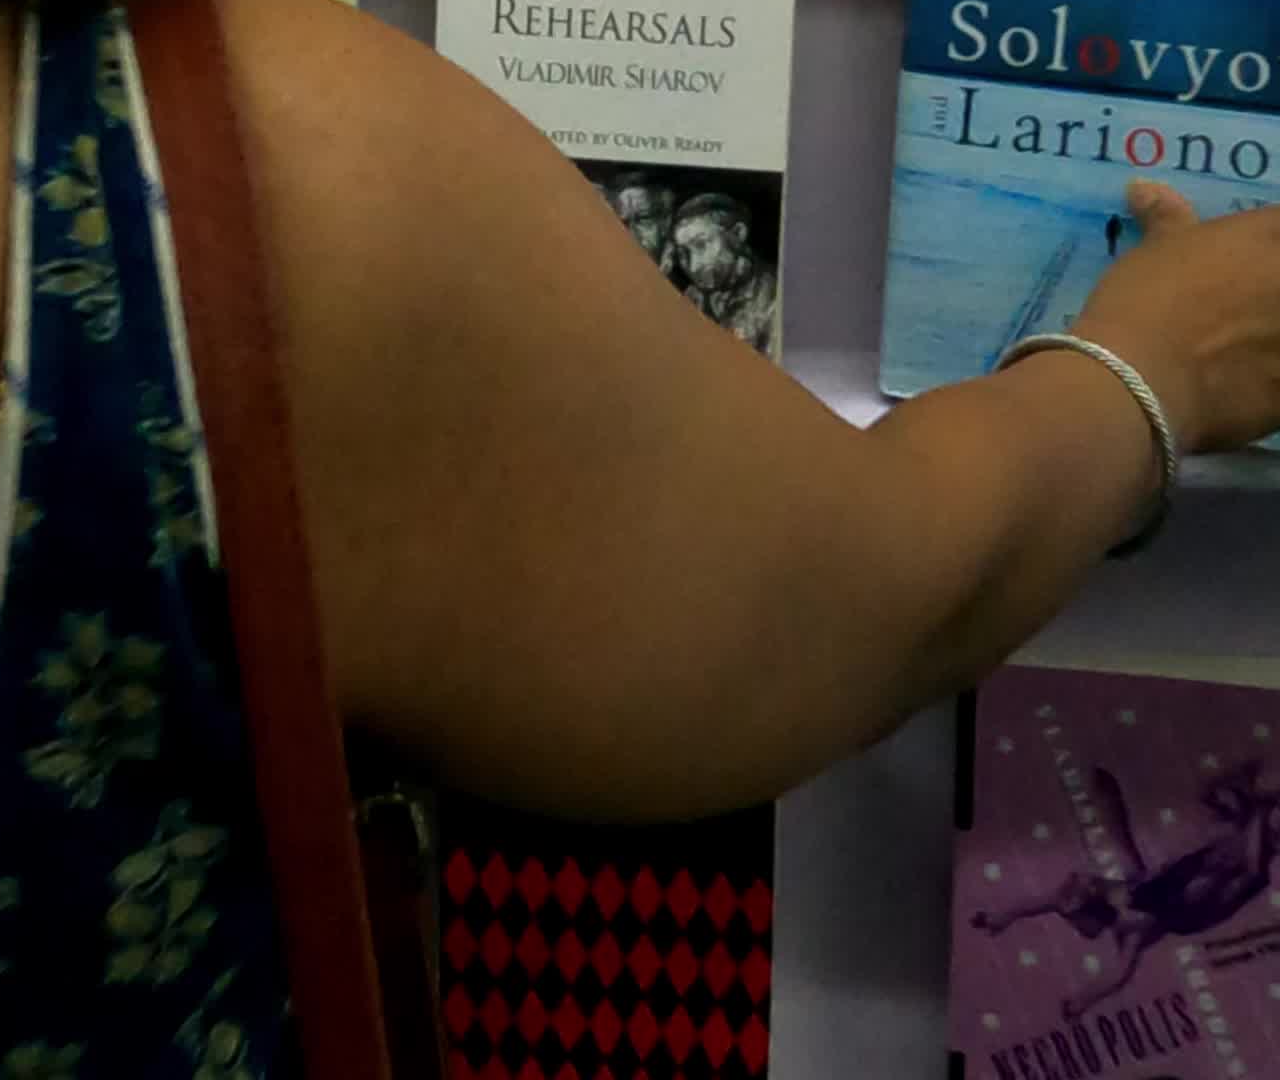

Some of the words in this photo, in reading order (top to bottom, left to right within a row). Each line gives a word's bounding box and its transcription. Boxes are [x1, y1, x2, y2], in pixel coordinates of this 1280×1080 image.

[498, 55, 617, 89] VLADIMIR
[624, 63, 725, 94] SHAROV
[592, 131, 611, 145] BY
[613, 133, 668, 151] OLIVER
[674, 135, 724, 153] READY
